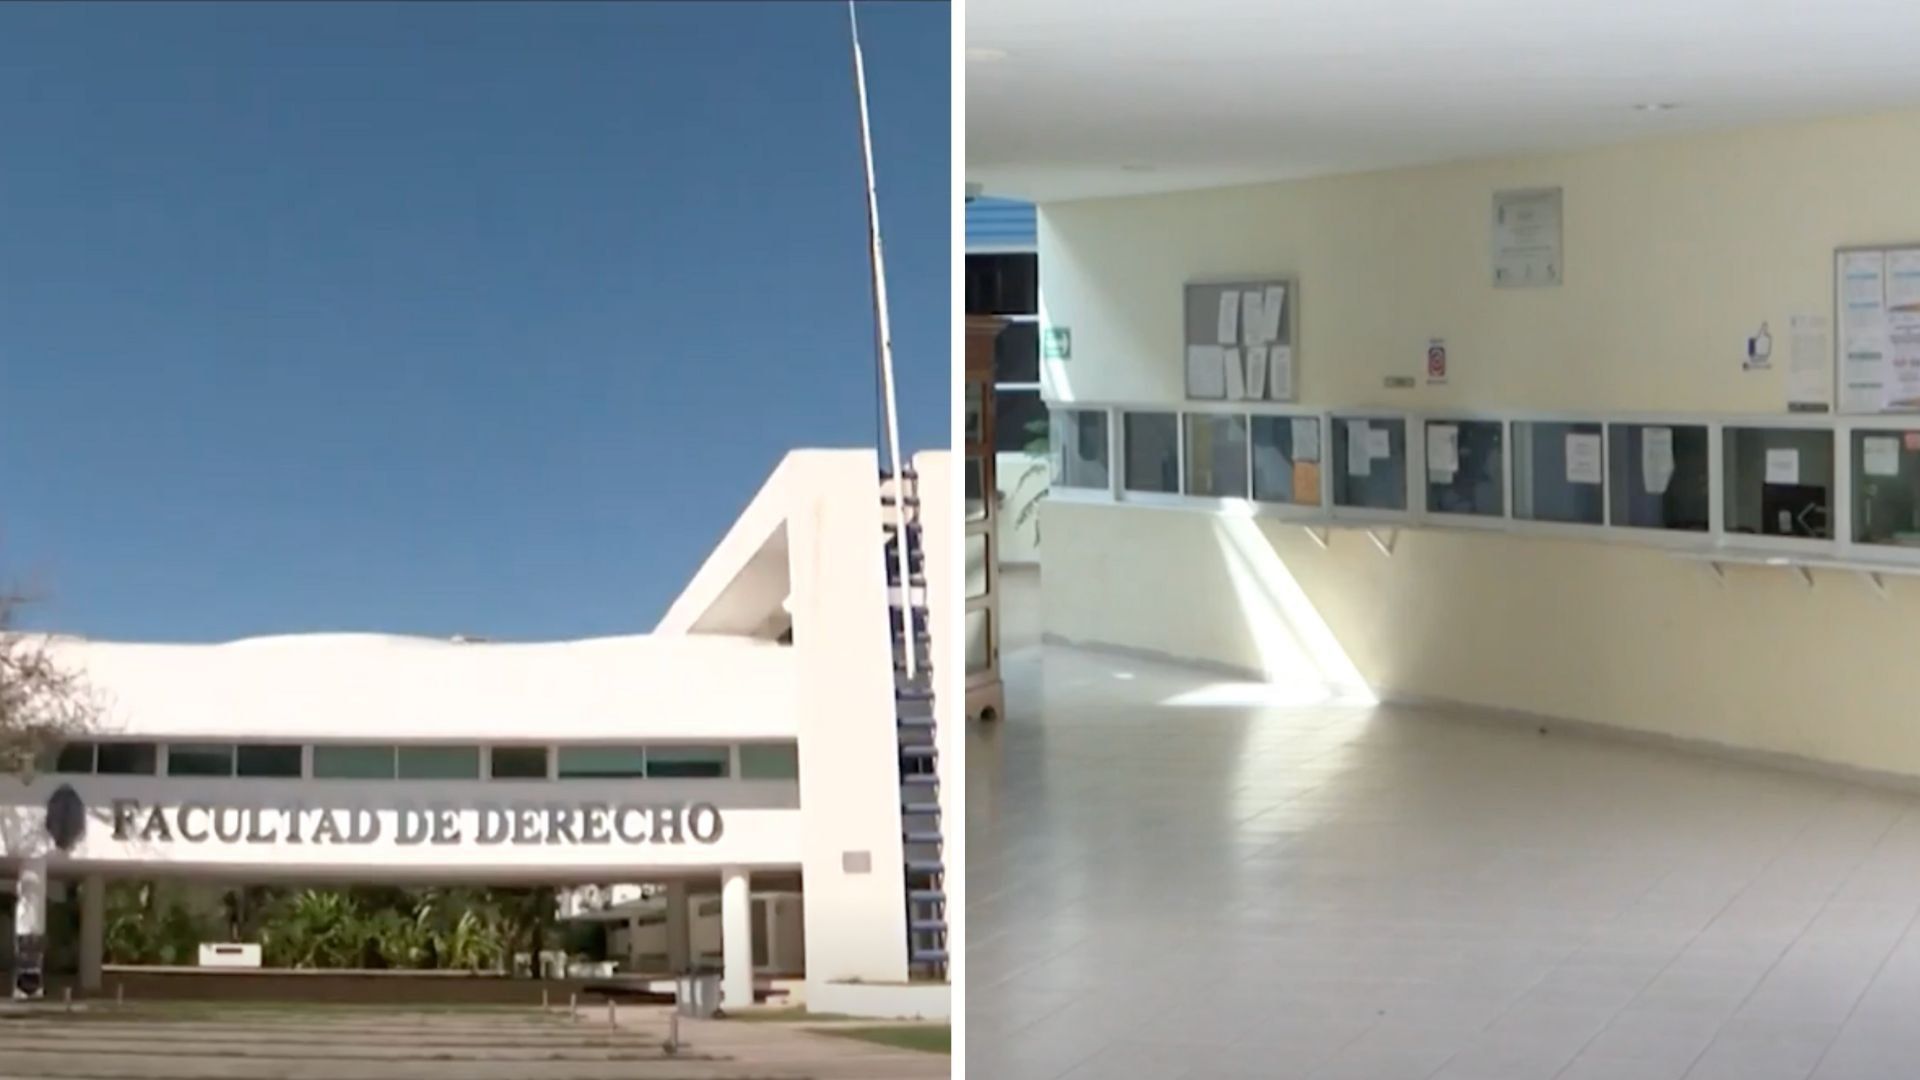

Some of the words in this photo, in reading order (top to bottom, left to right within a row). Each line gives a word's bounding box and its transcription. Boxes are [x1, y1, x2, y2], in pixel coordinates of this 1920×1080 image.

[110, 797, 381, 844] FACULTAD
[394, 802, 461, 845] DE
[475, 801, 724, 845] DERECHO
